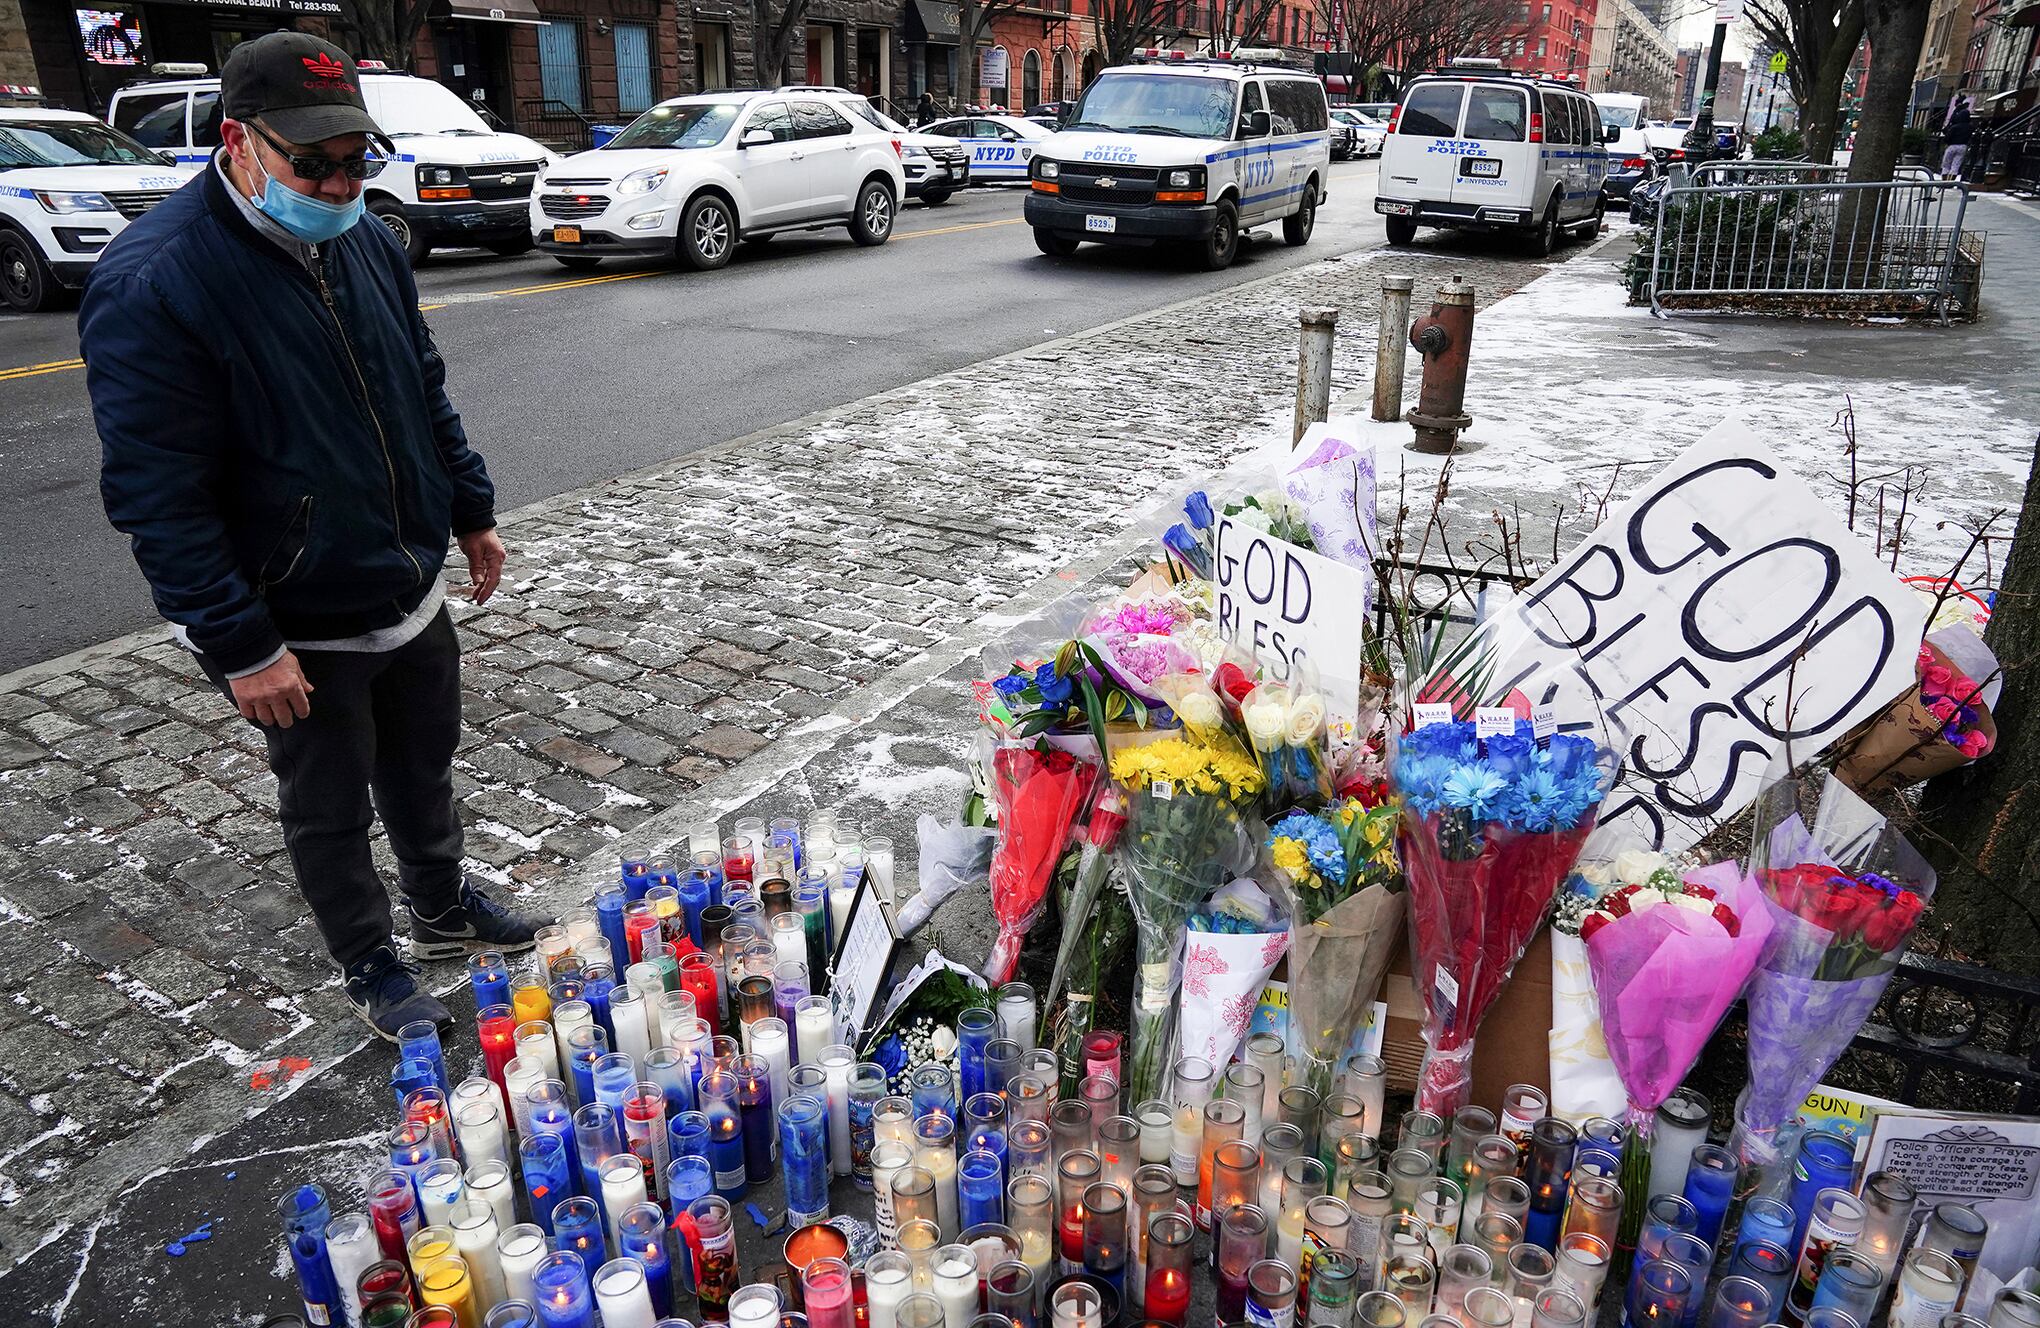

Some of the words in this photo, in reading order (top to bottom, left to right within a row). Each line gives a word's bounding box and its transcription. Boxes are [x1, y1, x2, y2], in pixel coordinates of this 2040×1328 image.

[248, 0, 281, 8] BEAUTY
[288, 0, 302, 10] Tel
[1435, 140, 1480, 148] NYPD
[974, 147, 1015, 160] NYPD
[1427, 146, 1487, 156] POLICE
[480, 153, 520, 162] POLICE
[1083, 151, 1138, 163] POLICE
[1474, 163, 1492, 172] 8552
[1465, 178, 1508, 186] @NYPD32PCT
[1088, 218, 1108, 228] 8529
[1217, 520, 1312, 624] GOD
[1626, 458, 1894, 739] GOD
[1518, 544, 1772, 818] BLESS
[1804, 1093, 1850, 1116] GUN
[1893, 1142, 1929, 1151] Police
[1934, 1144, 1985, 1154] Officer's
[1994, 1147, 2037, 1157] Prayer
[1938, 1162, 1977, 1171] conquer
[1970, 1157, 2012, 1165] courage
[1929, 1169, 1970, 1178] strength
[1988, 1172, 2013, 1181] body
[1925, 1176, 1956, 1184] others
[1982, 1180, 2024, 1189] strength
